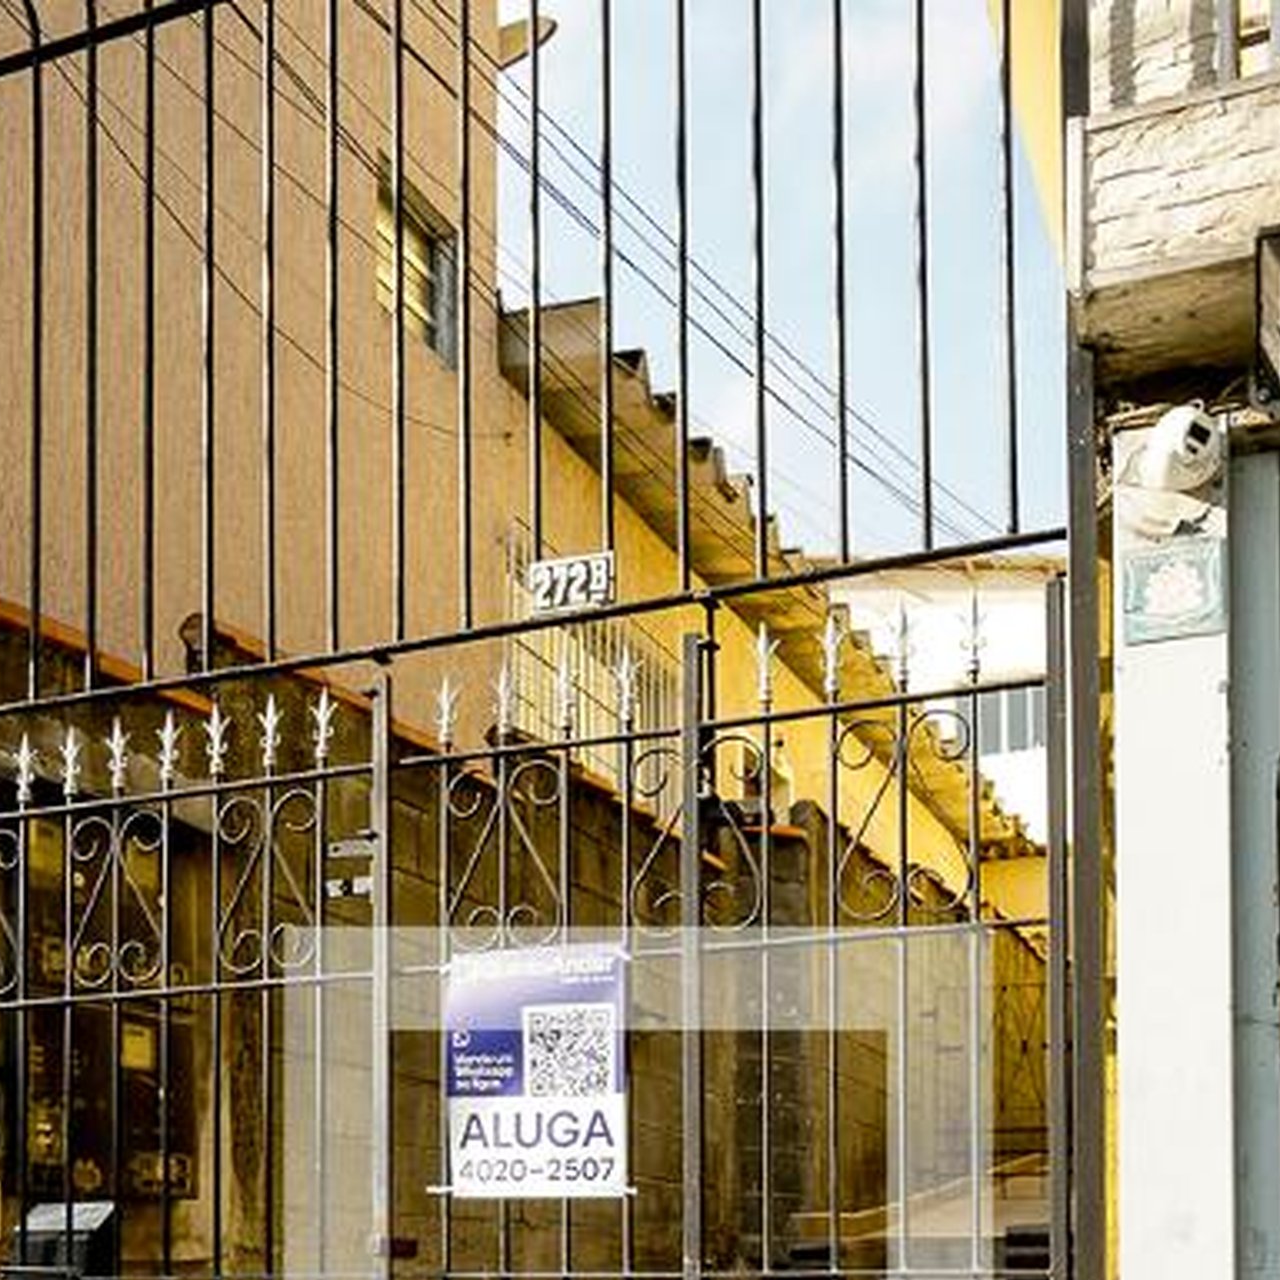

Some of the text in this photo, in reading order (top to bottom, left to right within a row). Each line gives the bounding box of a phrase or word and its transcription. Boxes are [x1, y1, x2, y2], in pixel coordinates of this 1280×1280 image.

[531, 556, 609, 611] 2728
[459, 1110, 615, 1148] ALUGA
[459, 1156, 615, 1183] 4020-2507
